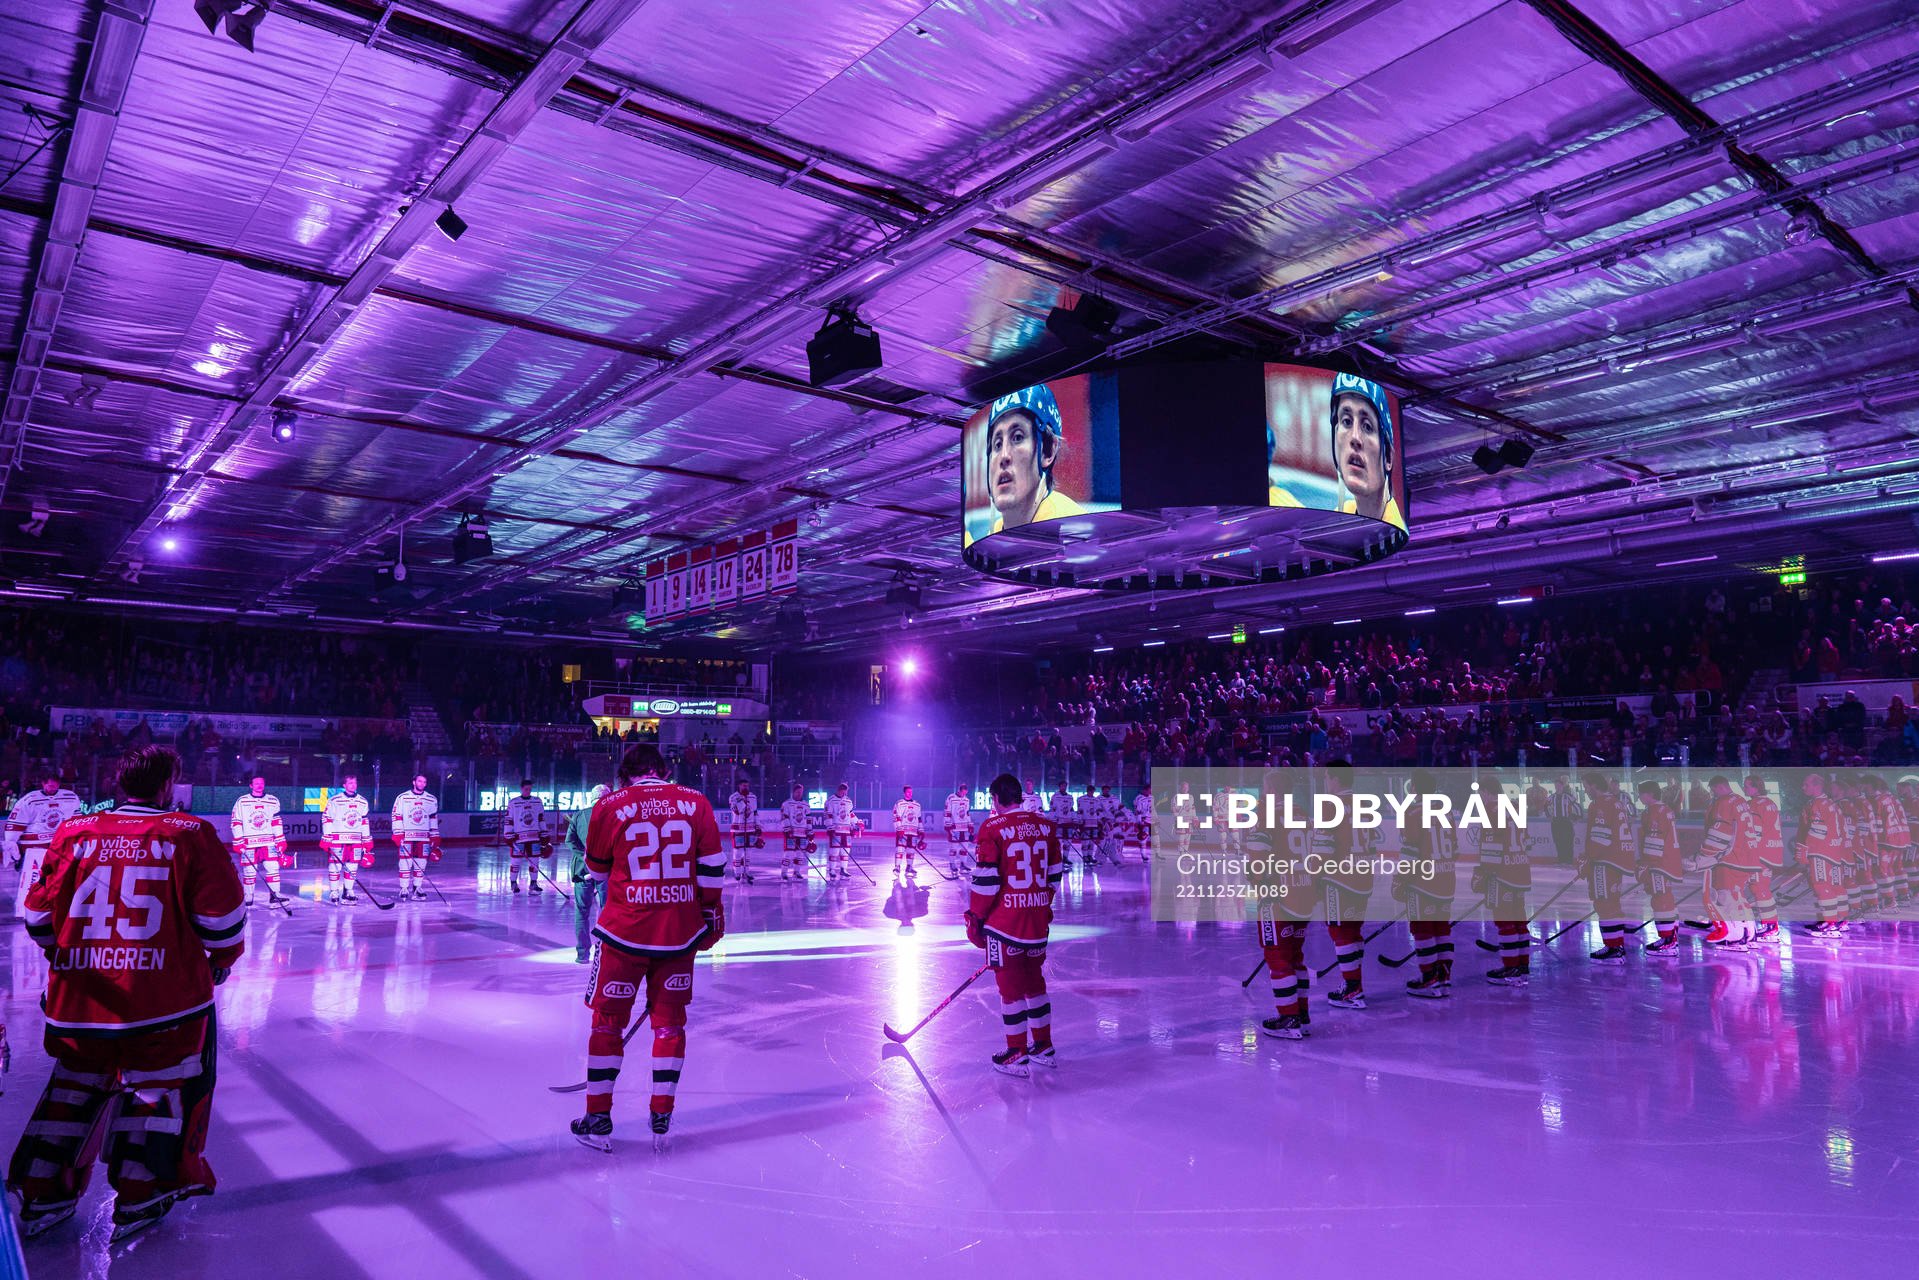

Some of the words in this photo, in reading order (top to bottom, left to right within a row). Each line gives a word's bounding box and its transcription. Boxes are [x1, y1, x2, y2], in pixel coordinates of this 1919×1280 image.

[745, 552, 763, 583] 24
[775, 543, 794, 574] 78
[694, 568, 707, 596] 14
[719, 561, 733, 590] 17
[652, 582, 657, 607] 1
[672, 575, 681, 601] 9
[639, 798, 670, 808] wibe
[641, 806, 677, 820] group
[65, 815, 99, 828] clean
[1016, 822, 1036, 832] wibe
[101, 836, 141, 849] wibe
[1018, 829, 1041, 841] group
[98, 848, 148, 863] group
[624, 820, 693, 881] 22
[1006, 840, 1049, 890] 33
[69, 865, 170, 941] 45
[626, 884, 695, 904] CARLSSON
[53, 947, 166, 971] LJUNGGREN
